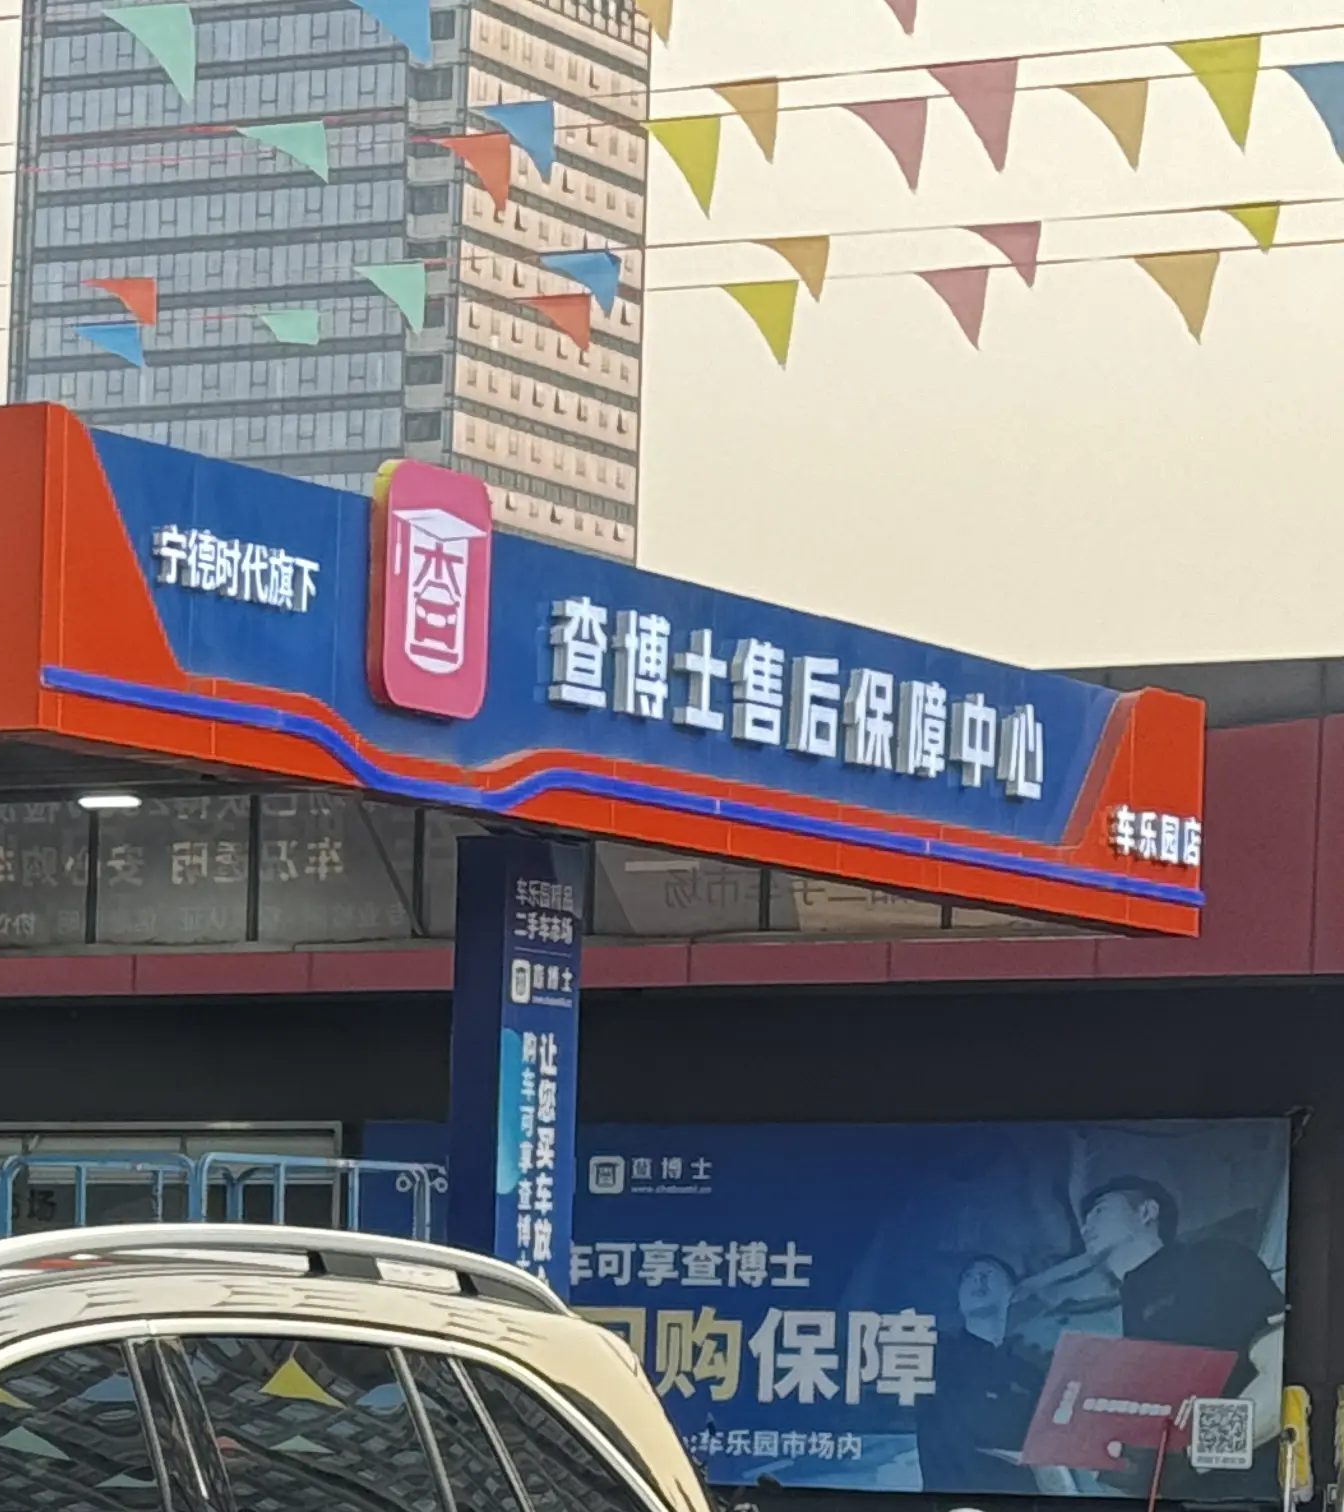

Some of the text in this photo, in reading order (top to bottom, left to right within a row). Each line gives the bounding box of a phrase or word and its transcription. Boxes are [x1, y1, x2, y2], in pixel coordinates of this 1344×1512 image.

[151, 524, 320, 613] 宁德时代旗下
[547, 595, 1045, 801] 查博士售后保障中心
[1108, 804, 1203, 867] 车乐园店
[630, 1156, 713, 1181] 查博士
